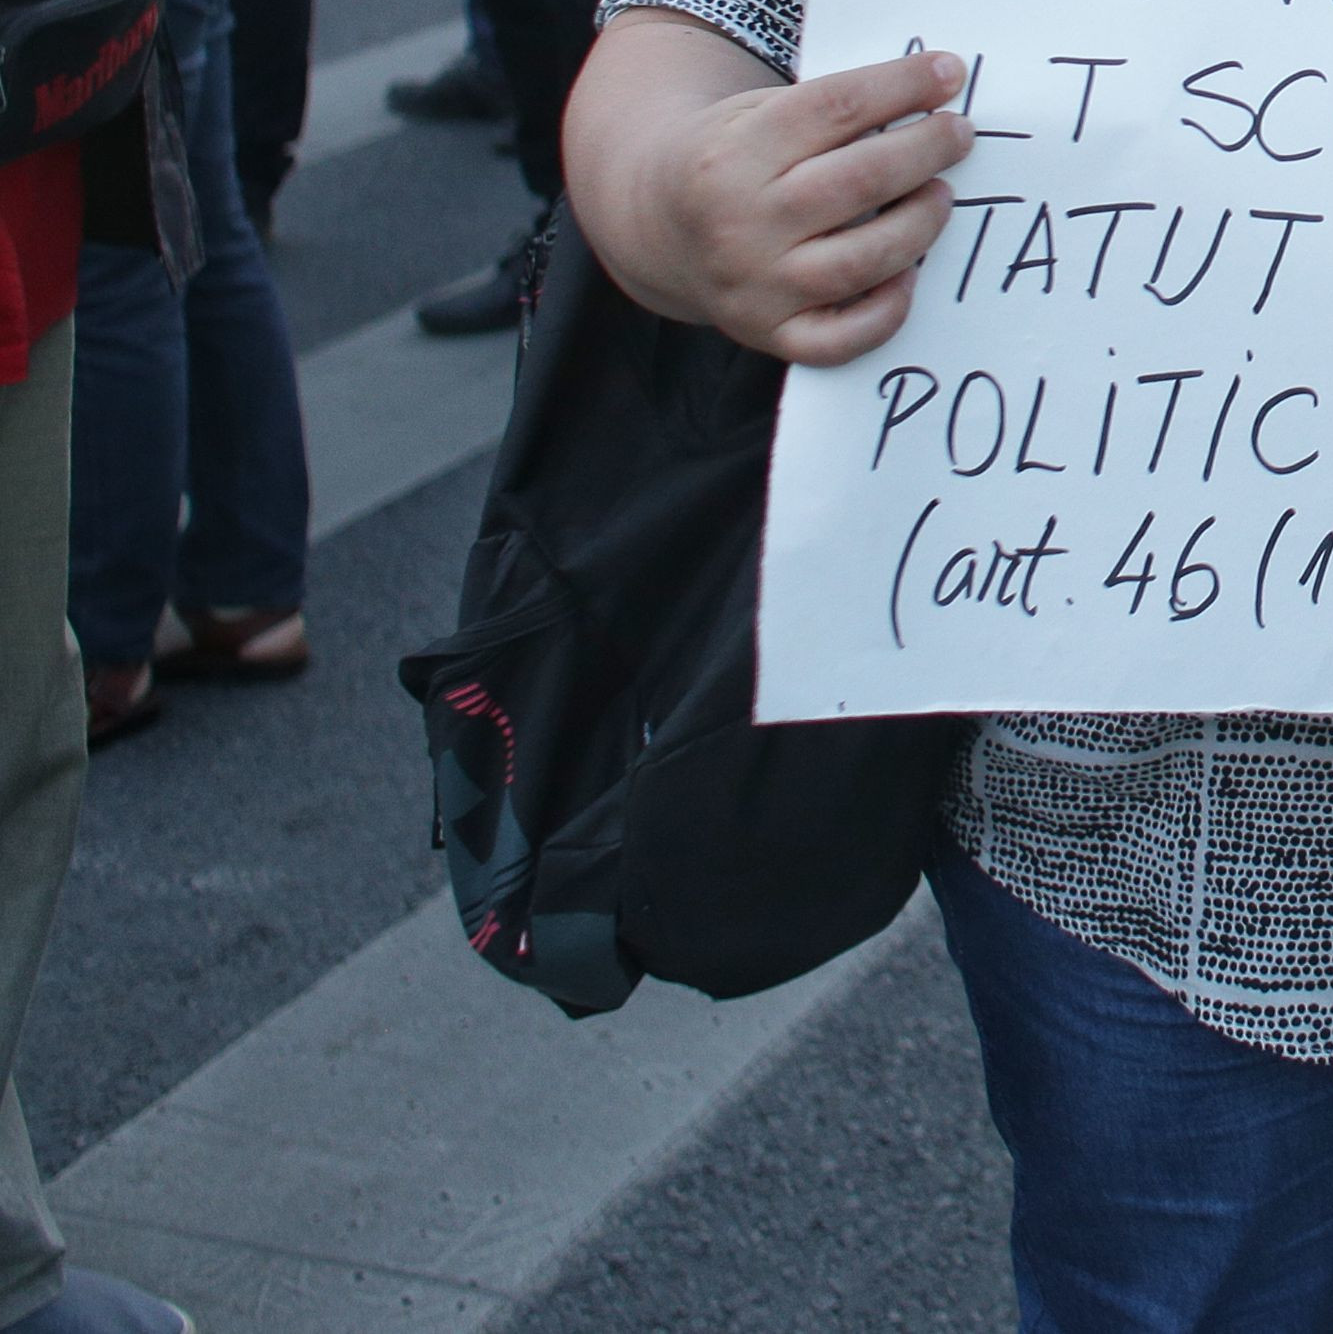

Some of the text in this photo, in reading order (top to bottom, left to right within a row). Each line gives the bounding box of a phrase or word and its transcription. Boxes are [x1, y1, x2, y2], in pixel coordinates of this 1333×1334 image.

[879, 35, 1128, 143] LT
[915, 195, 1325, 316] TATUT
[889, 497, 1075, 649] (art.
[1103, 510, 1220, 623] 46
